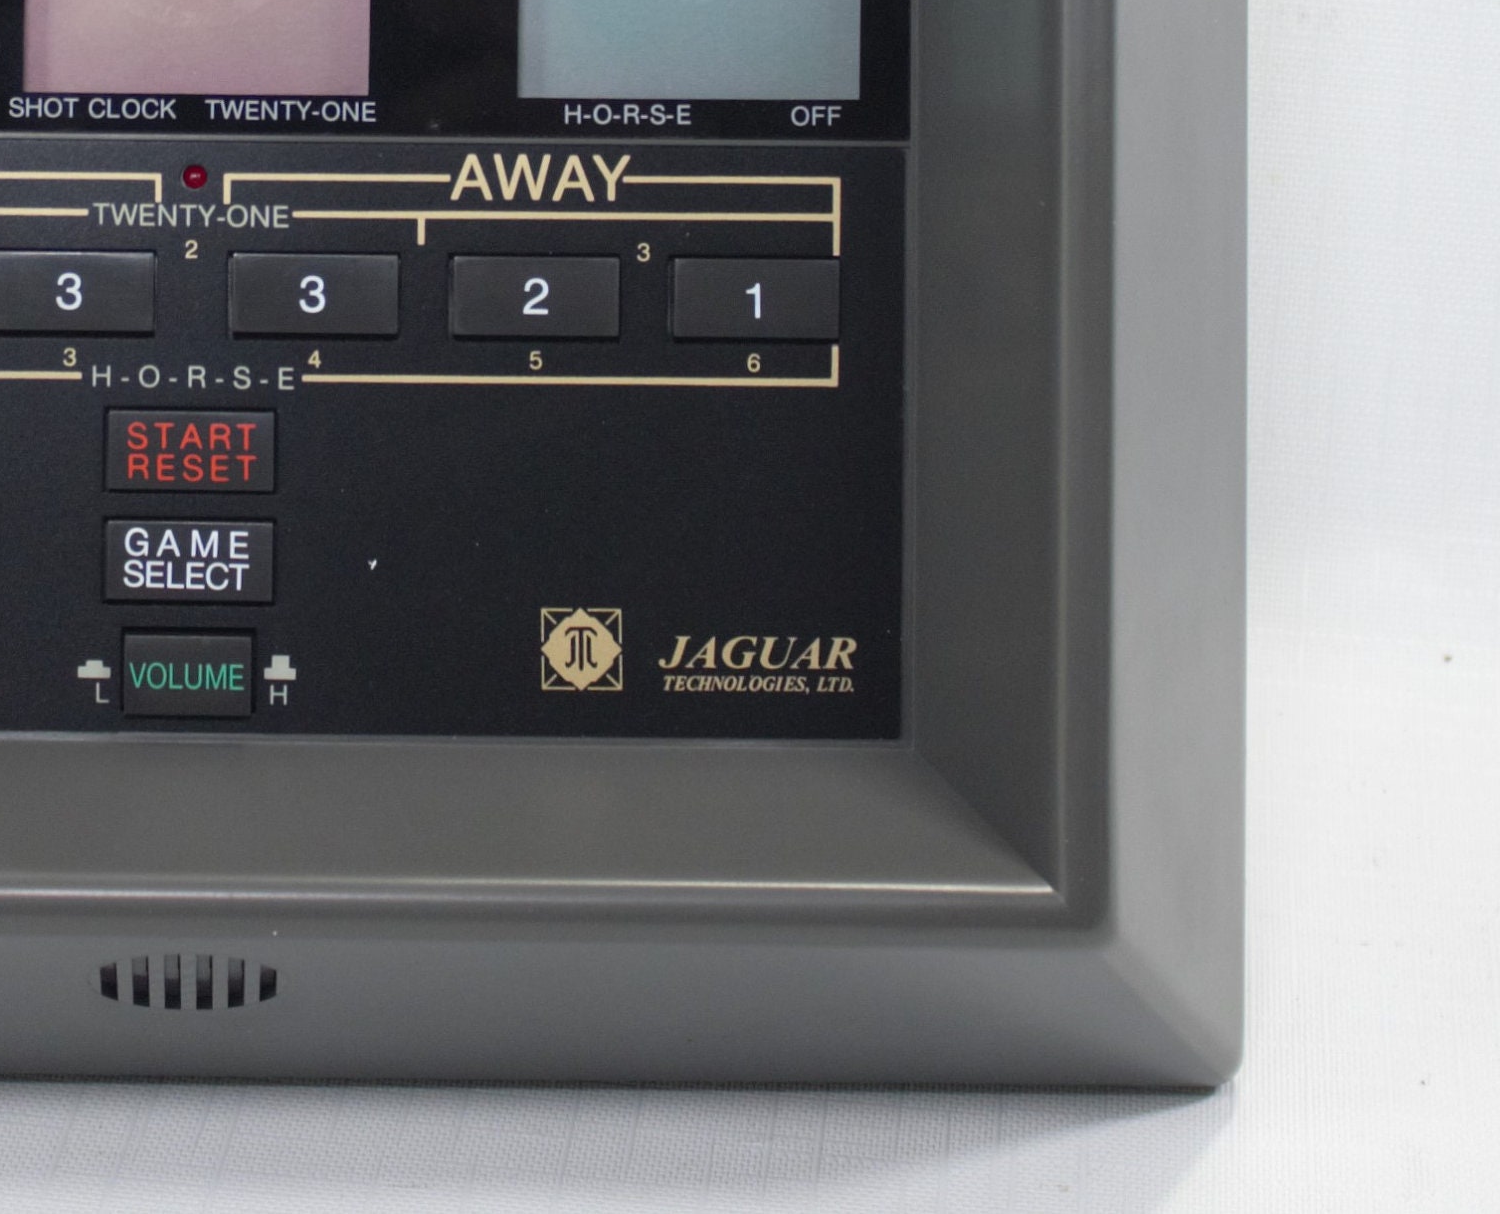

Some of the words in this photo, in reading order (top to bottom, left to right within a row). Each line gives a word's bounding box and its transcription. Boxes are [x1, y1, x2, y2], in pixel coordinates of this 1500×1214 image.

[8, 97, 79, 120] SHOT
[87, 98, 177, 121] CLOCK
[205, 99, 377, 123] TWENTY-ONE
[563, 104, 692, 127] H-O-R-S-E
[791, 106, 842, 127] OFF
[449, 153, 631, 202] AWAY
[92, 202, 290, 229] TWENTY-ONE
[184, 239, 199, 259] 2
[636, 242, 651, 262] 3
[54, 273, 83, 311] 3
[298, 275, 327, 314] 3
[522, 277, 550, 315] 2
[744, 282, 763, 319] 1
[62, 347, 77, 367] 3
[307, 349, 322, 370] 4
[528, 351, 543, 370] 5
[746, 352, 761, 372] 6
[126, 421, 257, 452] START
[127, 454, 257, 483] RESET
[124, 527, 249, 560] GAME
[123, 560, 250, 592] SELECT
[658, 636, 858, 670] JAGUAR
[129, 662, 245, 691] VOLUME
[662, 675, 811, 695] TECHNOLOGIES,
[817, 675, 856, 693] LTD.
[95, 682, 110, 704] L
[269, 684, 288, 706] H
